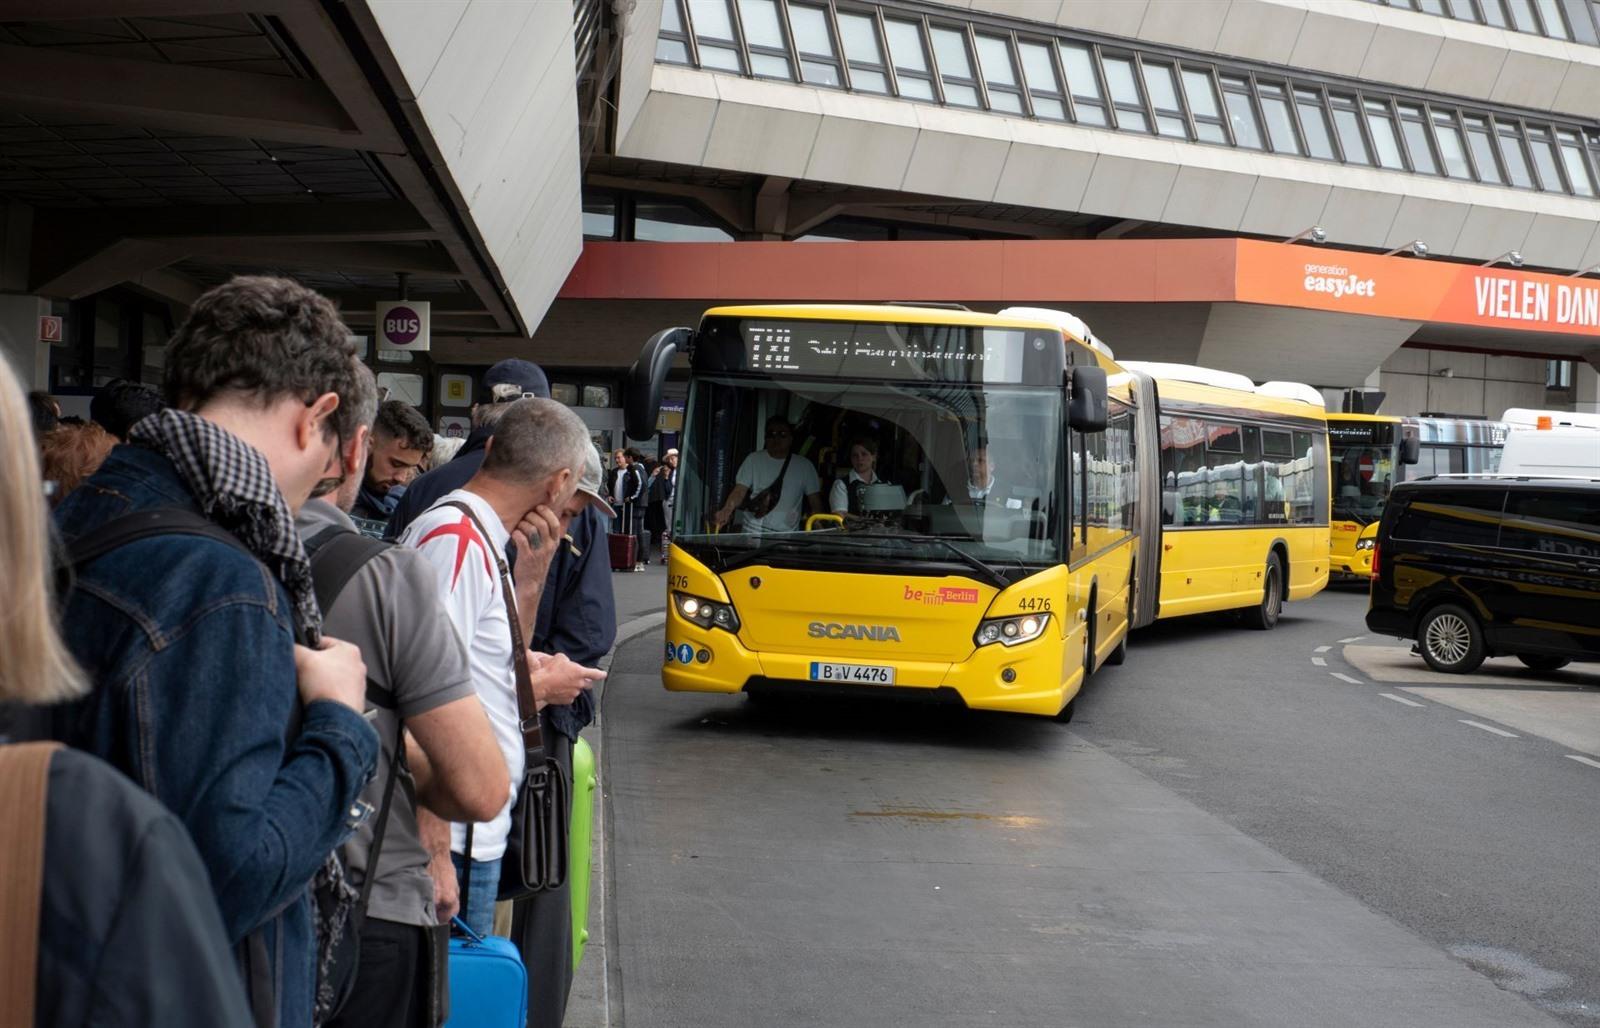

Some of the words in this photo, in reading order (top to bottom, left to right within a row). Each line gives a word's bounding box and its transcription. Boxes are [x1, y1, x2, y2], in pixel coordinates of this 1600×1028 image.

[1304, 264, 1348, 275] generation
[1304, 275, 1376, 298] easyJet
[1474, 276, 1549, 321] VIELEN
[1557, 285, 1600, 327] DAN
[386, 319, 418, 333] BUS
[904, 585, 923, 601] be
[946, 590, 975, 601] Berlin
[1018, 598, 1051, 611] 4476
[807, 621, 902, 642] SCANIA
[823, 665, 832, 679] B
[842, 666, 851, 680] V
[854, 667, 888, 682] 4476
